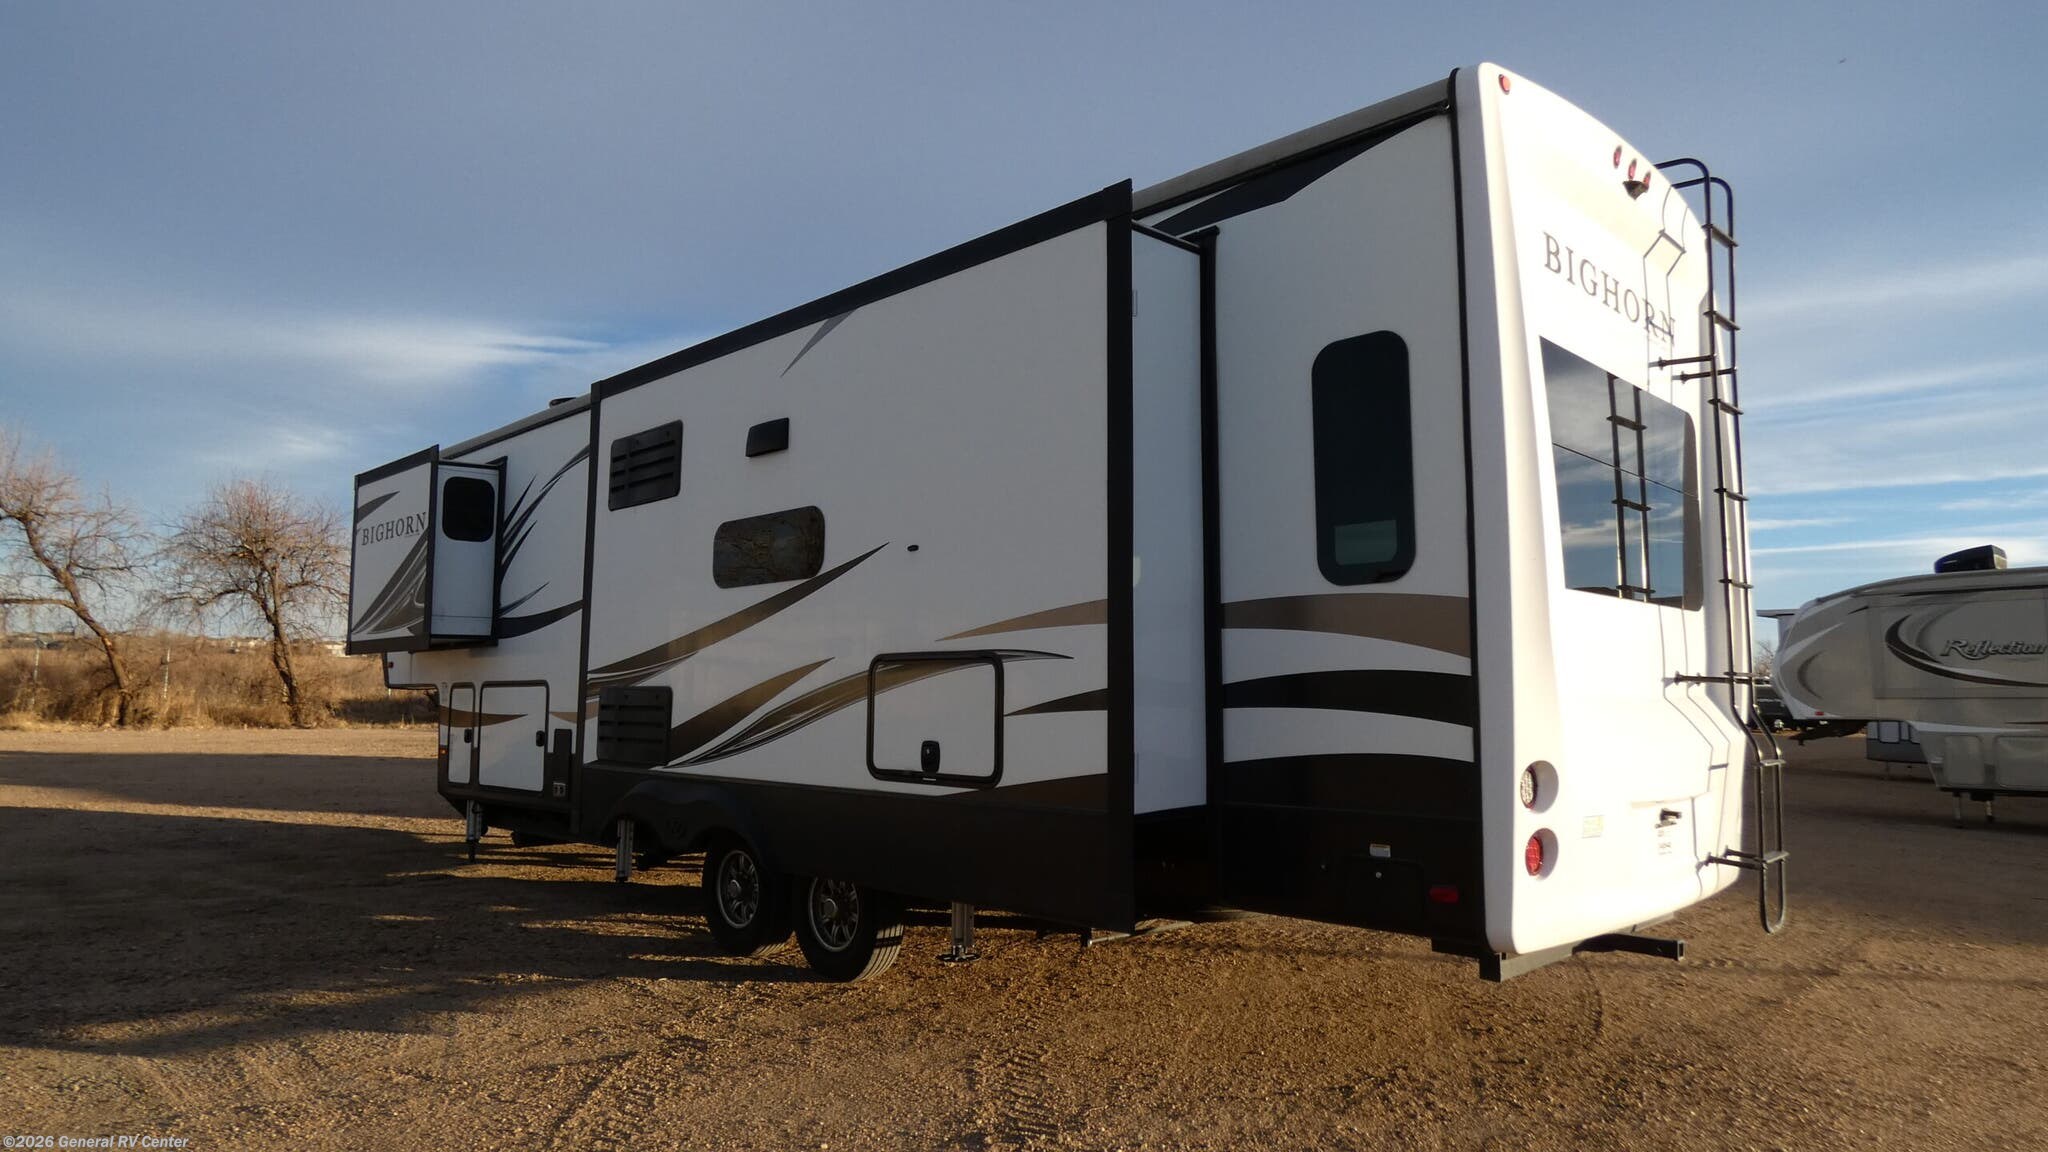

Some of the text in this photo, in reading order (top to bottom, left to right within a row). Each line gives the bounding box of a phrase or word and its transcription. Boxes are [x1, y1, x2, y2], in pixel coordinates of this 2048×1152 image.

[1543, 231, 1675, 344] BIGHORN
[361, 512, 426, 545] BIGHORN
[1939, 639, 2048, 661] Reflection
